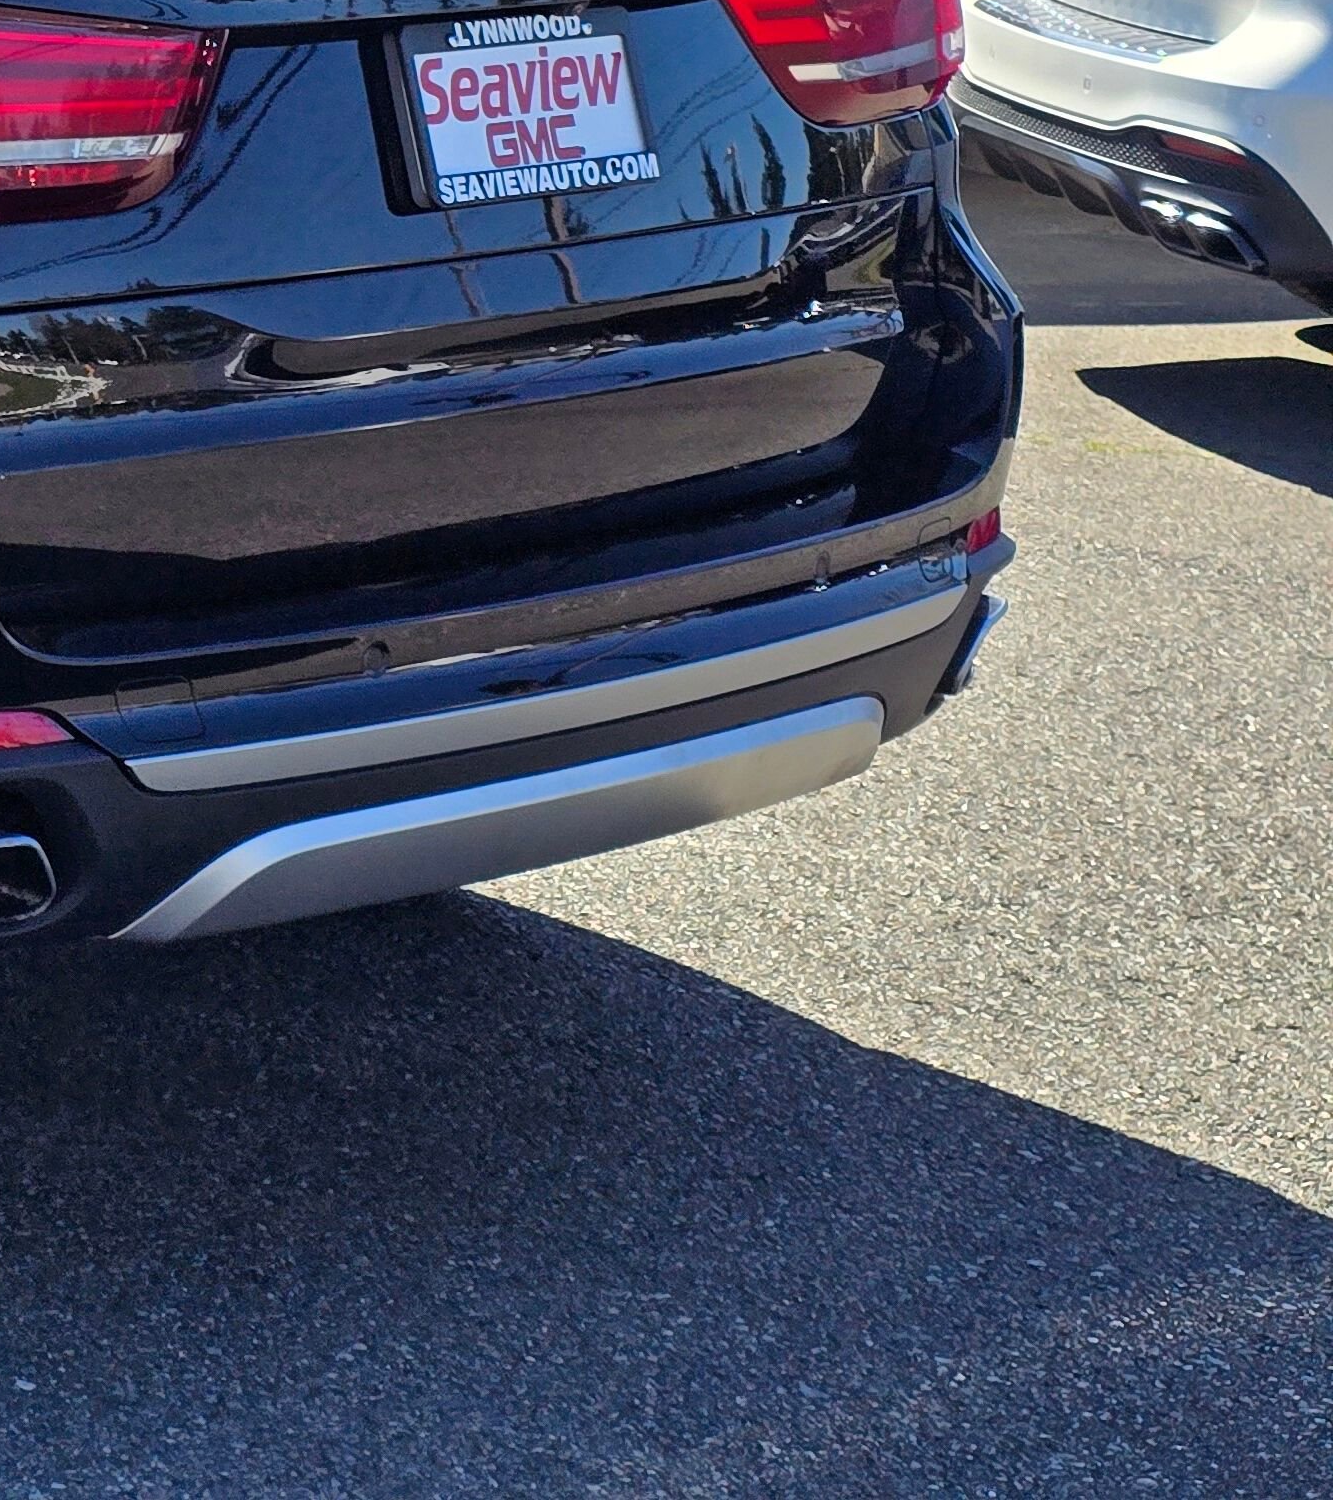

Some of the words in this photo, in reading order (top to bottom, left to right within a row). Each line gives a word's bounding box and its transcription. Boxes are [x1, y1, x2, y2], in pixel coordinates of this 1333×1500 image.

[452, 14, 582, 48] LYNNWOOD
[420, 46, 622, 125] Seaview
[486, 113, 586, 169] GMC
[438, 152, 661, 204] SEAVIEWAUTO.COM
